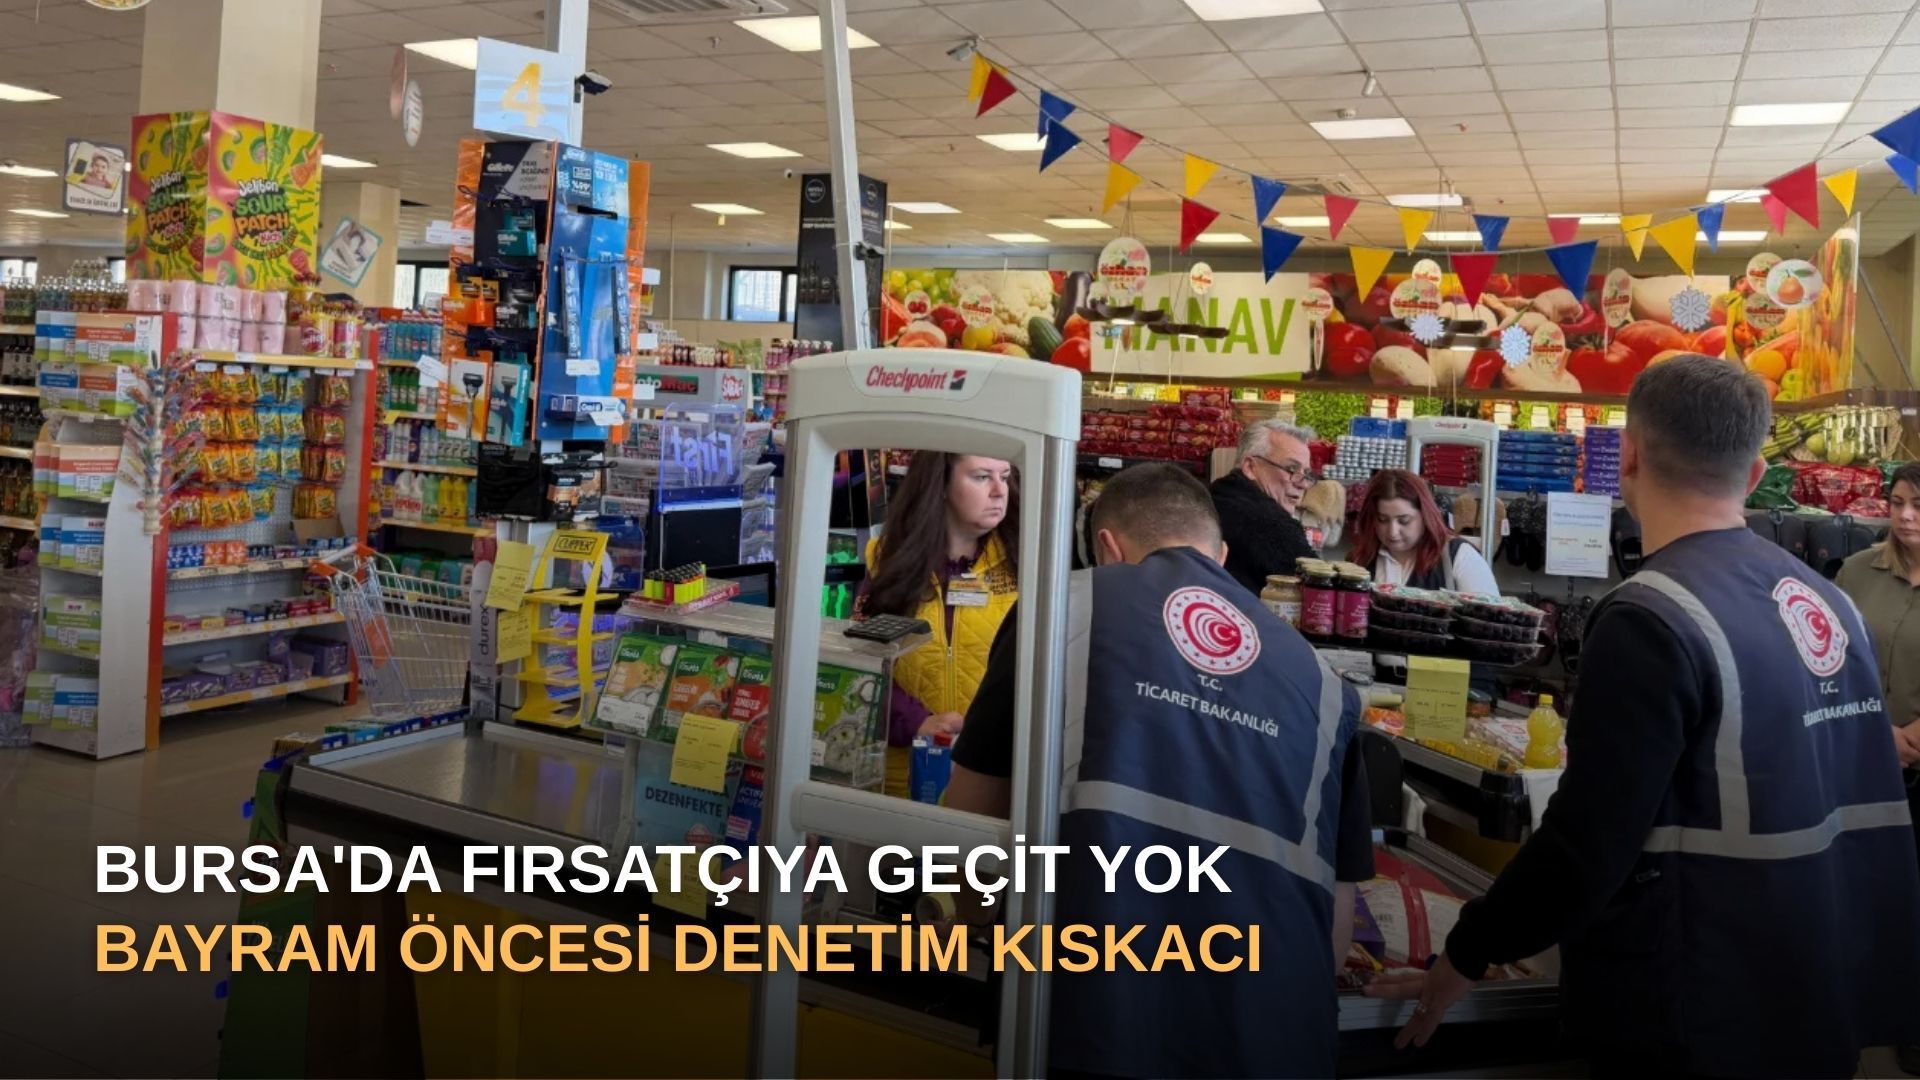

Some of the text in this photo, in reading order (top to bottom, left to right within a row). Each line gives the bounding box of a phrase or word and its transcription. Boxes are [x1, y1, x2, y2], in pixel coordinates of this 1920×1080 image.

[501, 61, 546, 128] 4
[147, 201, 190, 231] PATCH
[235, 195, 287, 216] SOUR
[234, 212, 289, 236] PATCH
[866, 365, 948, 393] Checkpoint
[556, 534, 595, 552] CLIPPER
[479, 604, 490, 656] durex
[1198, 674, 1223, 691] T.C.
[1819, 681, 1839, 694] T.C.
[1135, 681, 1280, 738] TİCARET BAKANLIĞI
[1823, 697, 1882, 721] BAKANLIĞI
[645, 785, 723, 818] DEZENFEKTE
